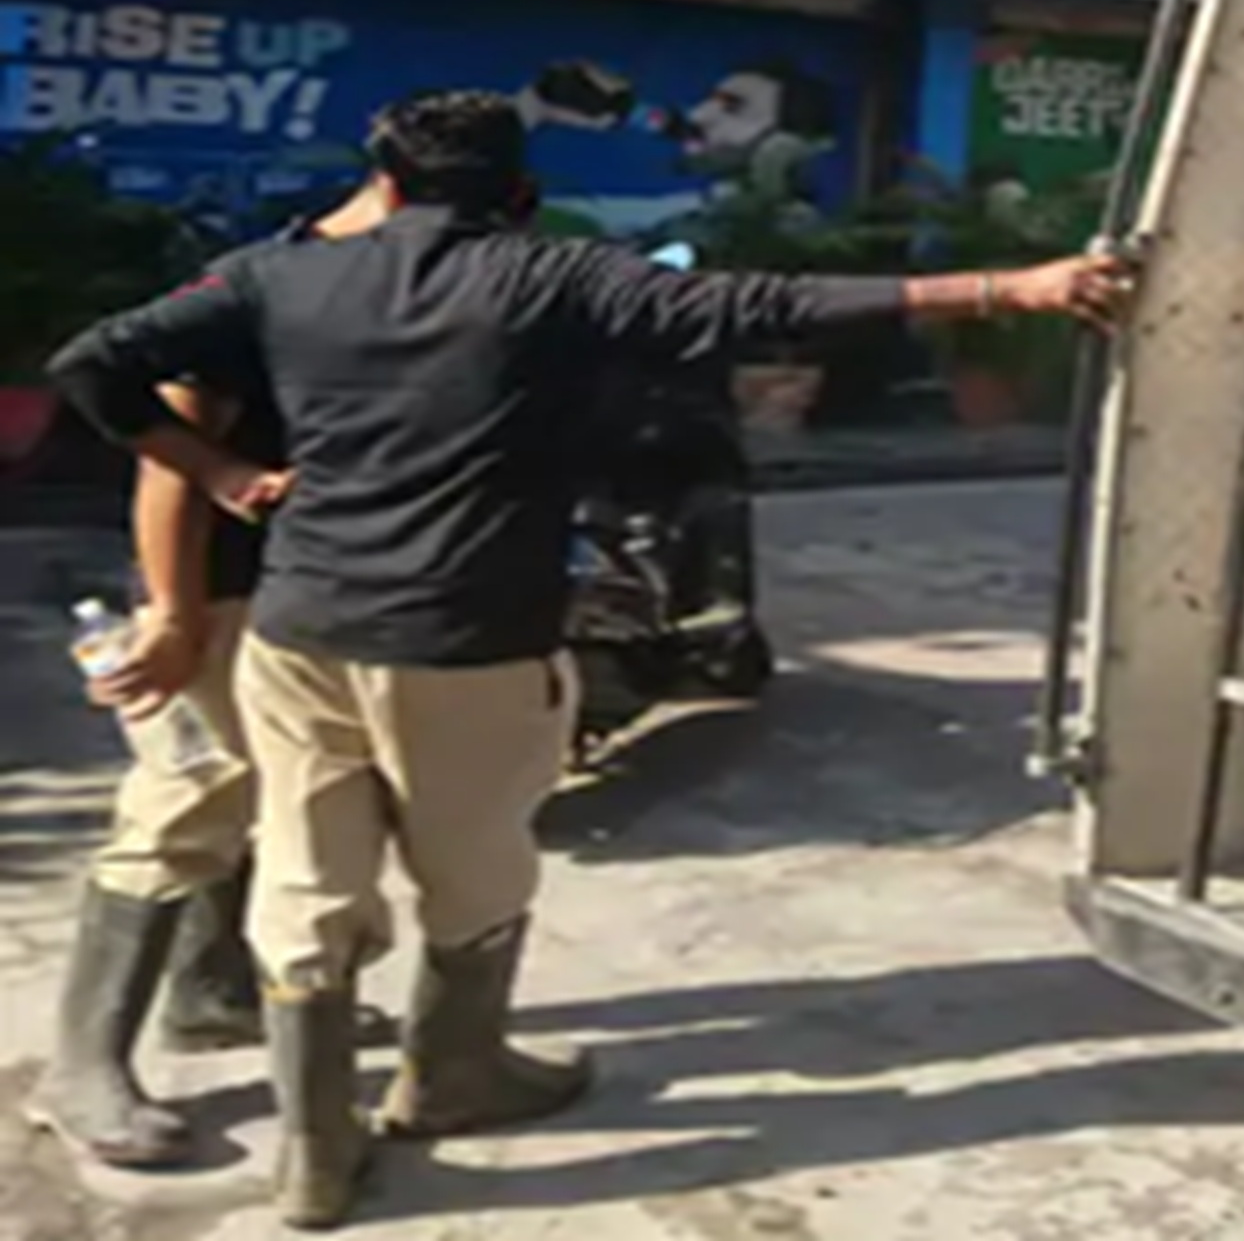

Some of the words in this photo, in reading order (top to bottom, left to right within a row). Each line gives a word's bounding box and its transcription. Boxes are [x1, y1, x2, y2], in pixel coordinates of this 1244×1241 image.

[236, 17, 352, 69] UP
[0, 62, 332, 141] BABY!
[1000, 93, 1123, 138] JEET
